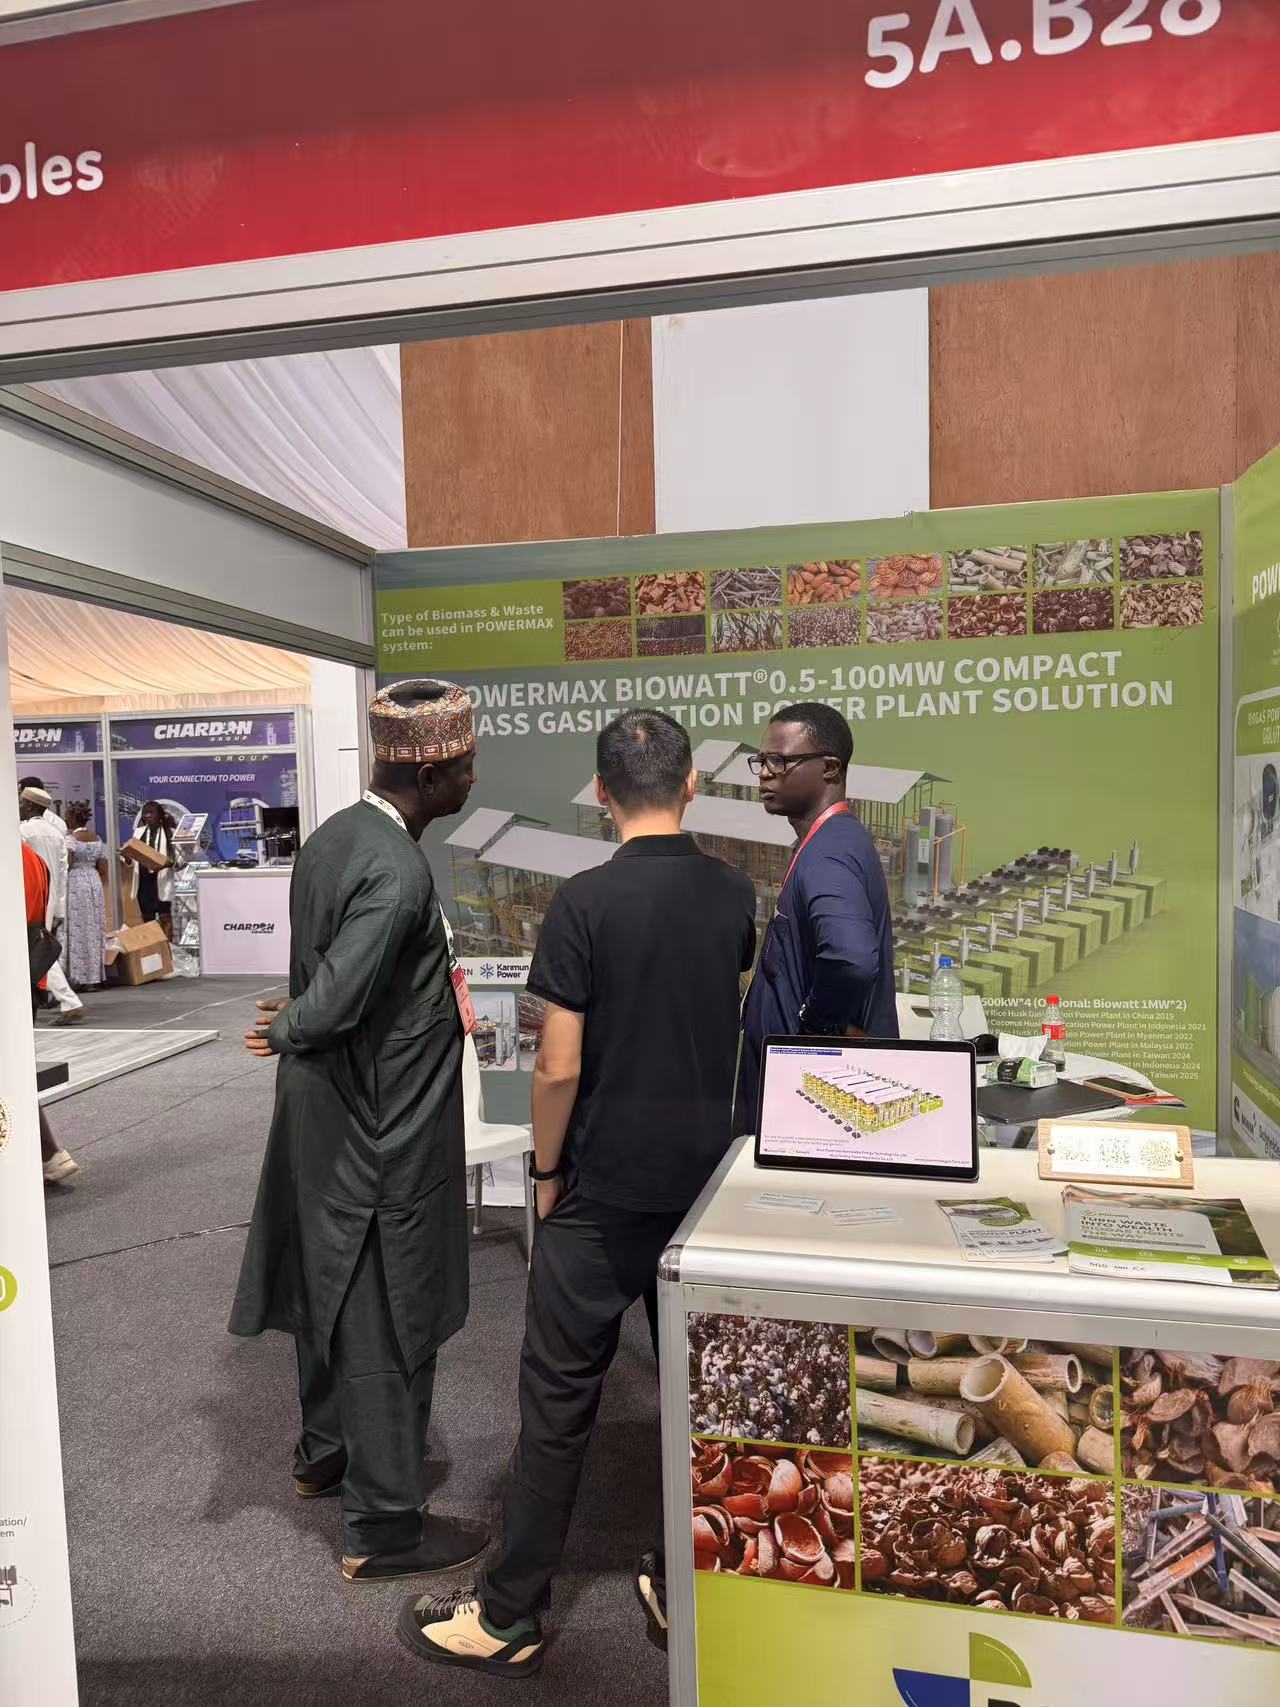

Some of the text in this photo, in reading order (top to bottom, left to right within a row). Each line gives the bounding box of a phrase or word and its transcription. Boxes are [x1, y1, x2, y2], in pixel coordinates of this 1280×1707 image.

[1252, 562, 1280, 605] POW
[382, 605, 544, 624] Type of Biomass & Waste
[382, 618, 554, 638] can be used in POWERMAX
[383, 639, 433, 654] system:
[468, 681, 608, 710] OWERMAX
[953, 650, 1122, 684] COMPACT
[472, 680, 1173, 737] ASS GASIFTION PER PLANT SOLUTION
[153, 720, 253, 740] CHARDON
[149, 773, 256, 784] YOUR CONNECTION TO POWER
[496, 970, 521, 979] Power
[1033, 997, 1091, 1010] (Oional:
[1093, 998, 1138, 1010] Biowatt
[991, 1010, 1008, 1018] Rice
[1008, 1010, 1028, 1018] Husk
[1075, 1011, 1099, 1019] Power
[1101, 1011, 1121, 1019] Plant
[1122, 1011, 1131, 1019] in
[1132, 1011, 1153, 1020] China
[1155, 1012, 1175, 1020] 2019
[991, 1019, 1022, 1027] Coconut
[1091, 1021, 1115, 1029] Power
[1116, 1021, 1136, 1029] Plant
[1138, 1021, 1147, 1029] in
[1148, 1021, 1186, 1030] Indonesia
[1187, 1022, 1207, 1031] 2021
[1079, 1031, 1104, 1039] Power
[1106, 1031, 1126, 1039] Plant
[1127, 1031, 1136, 1039] in
[1137, 1031, 1174, 1041] Myanmar
[1174, 1032, 1193, 1040] 2022
[1083, 1040, 1108, 1048] Power
[1109, 1040, 1130, 1049] Plant
[1131, 1041, 1139, 1049] in
[1140, 1041, 1174, 1051] Malaysia
[1174, 1042, 1194, 1050] 2022
[1111, 1050, 1131, 1059] Plant
[1133, 1051, 1140, 1059] in
[1142, 1051, 1171, 1060] Taiwan
[1171, 1052, 1191, 1060] 2024
[1142, 1061, 1180, 1069] Indonesia
[1180, 1062, 1201, 1071] 2024
[1150, 1071, 1178, 1080] Taiwan
[1180, 1072, 1199, 1080] 2025
[1081, 1216, 1168, 1228] TURN WASTE
[1081, 1220, 1173, 1233] INTO WEALTH
[1009, 1227, 1042, 1236] PLANT
[1081, 1225, 1133, 1234] BIOGAS
